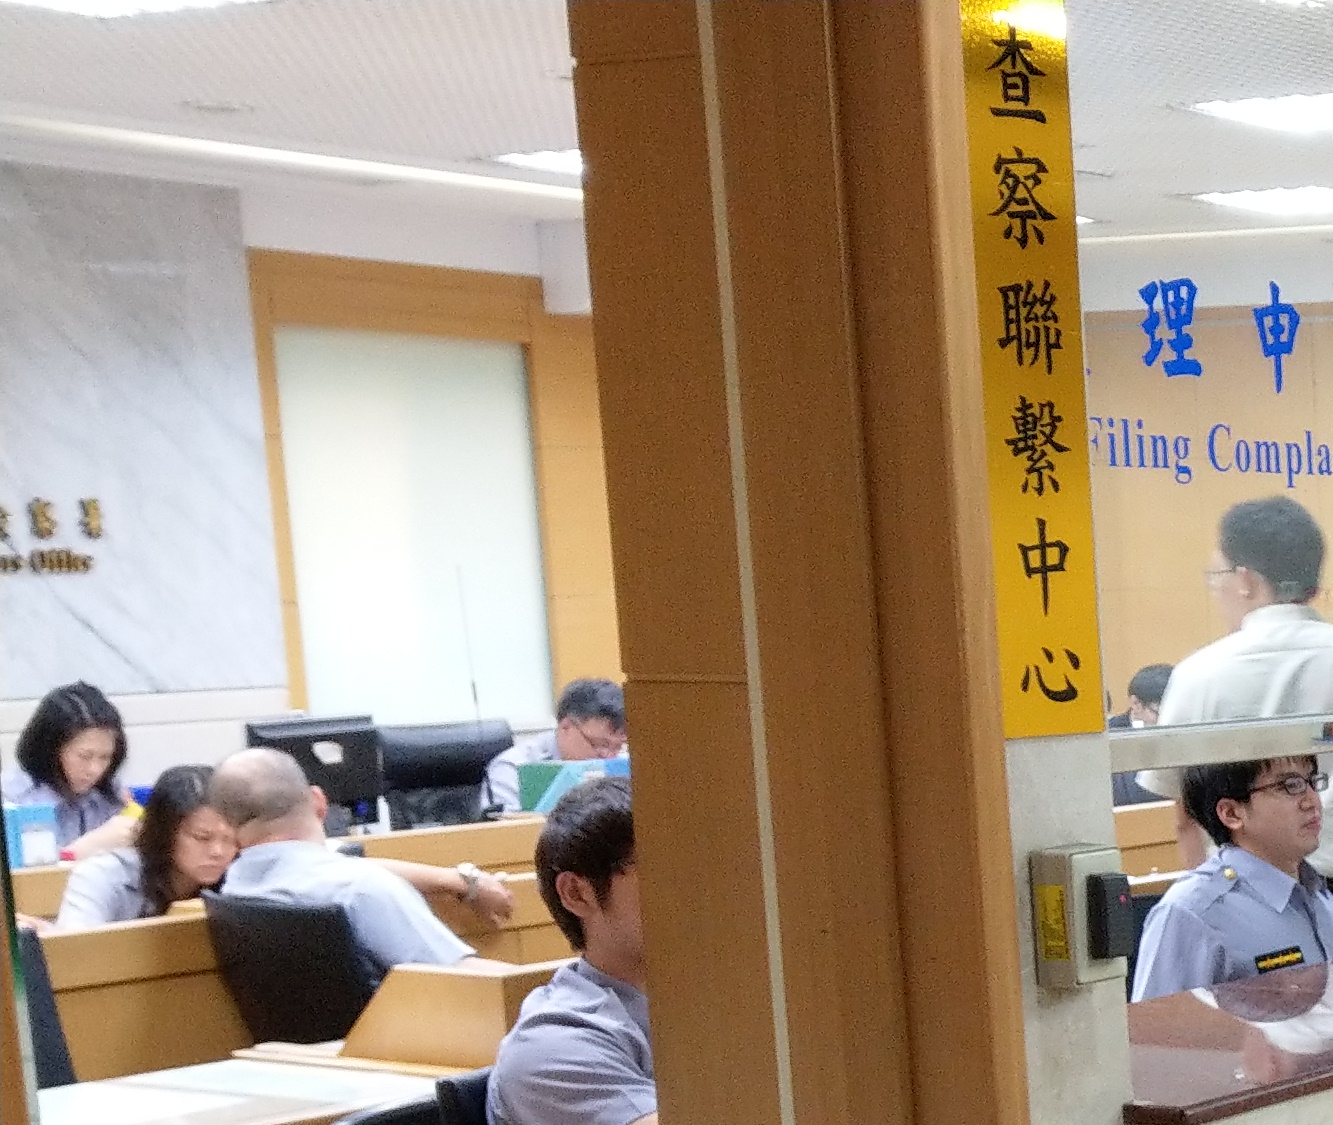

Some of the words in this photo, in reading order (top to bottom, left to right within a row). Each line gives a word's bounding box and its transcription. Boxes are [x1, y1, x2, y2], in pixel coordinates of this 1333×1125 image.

[986, 22, 1081, 703] 查察聯繫中心
